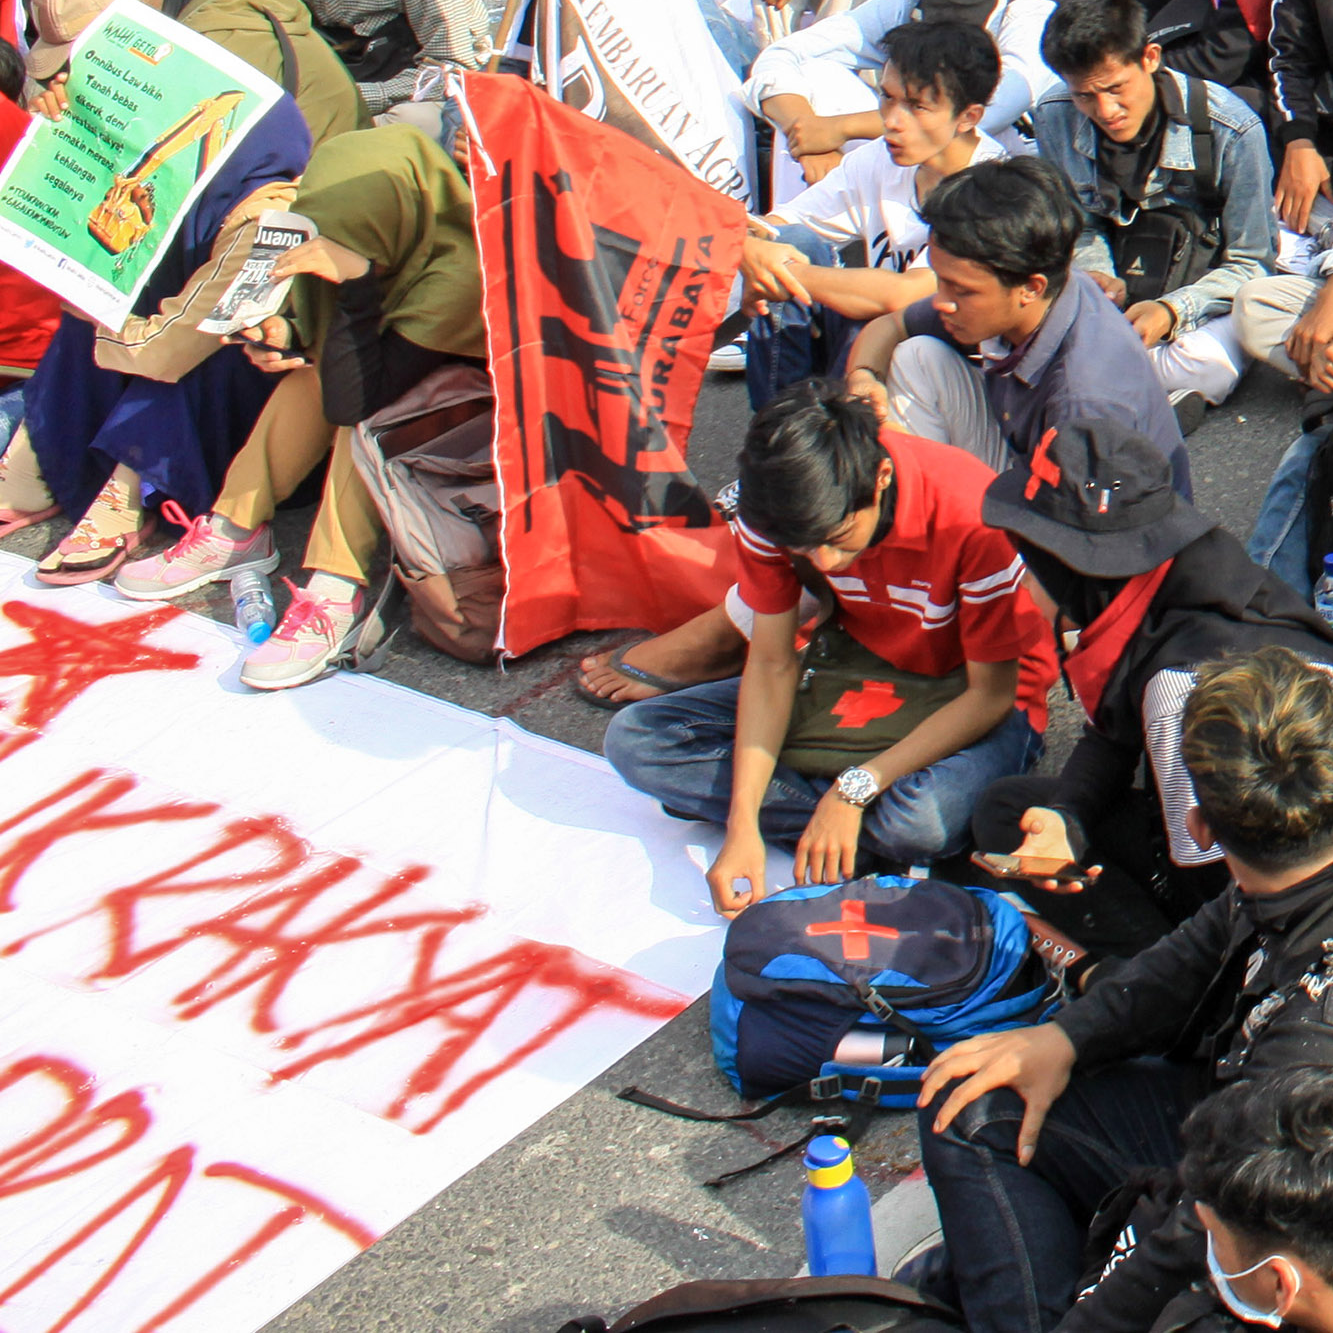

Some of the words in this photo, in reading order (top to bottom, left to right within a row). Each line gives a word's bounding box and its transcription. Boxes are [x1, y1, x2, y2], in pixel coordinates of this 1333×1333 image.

[84, 49, 122, 79] Omnibus
[122, 69, 144, 89] Law
[142, 80, 164, 102] bikin
[85, 73, 112, 97] Tanah
[112, 92, 139, 113] bebas
[105, 112, 130, 132] demi
[52, 126, 87, 153] semakin
[53, 150, 97, 184] kehilangan
[43, 171, 85, 203] segalanya
